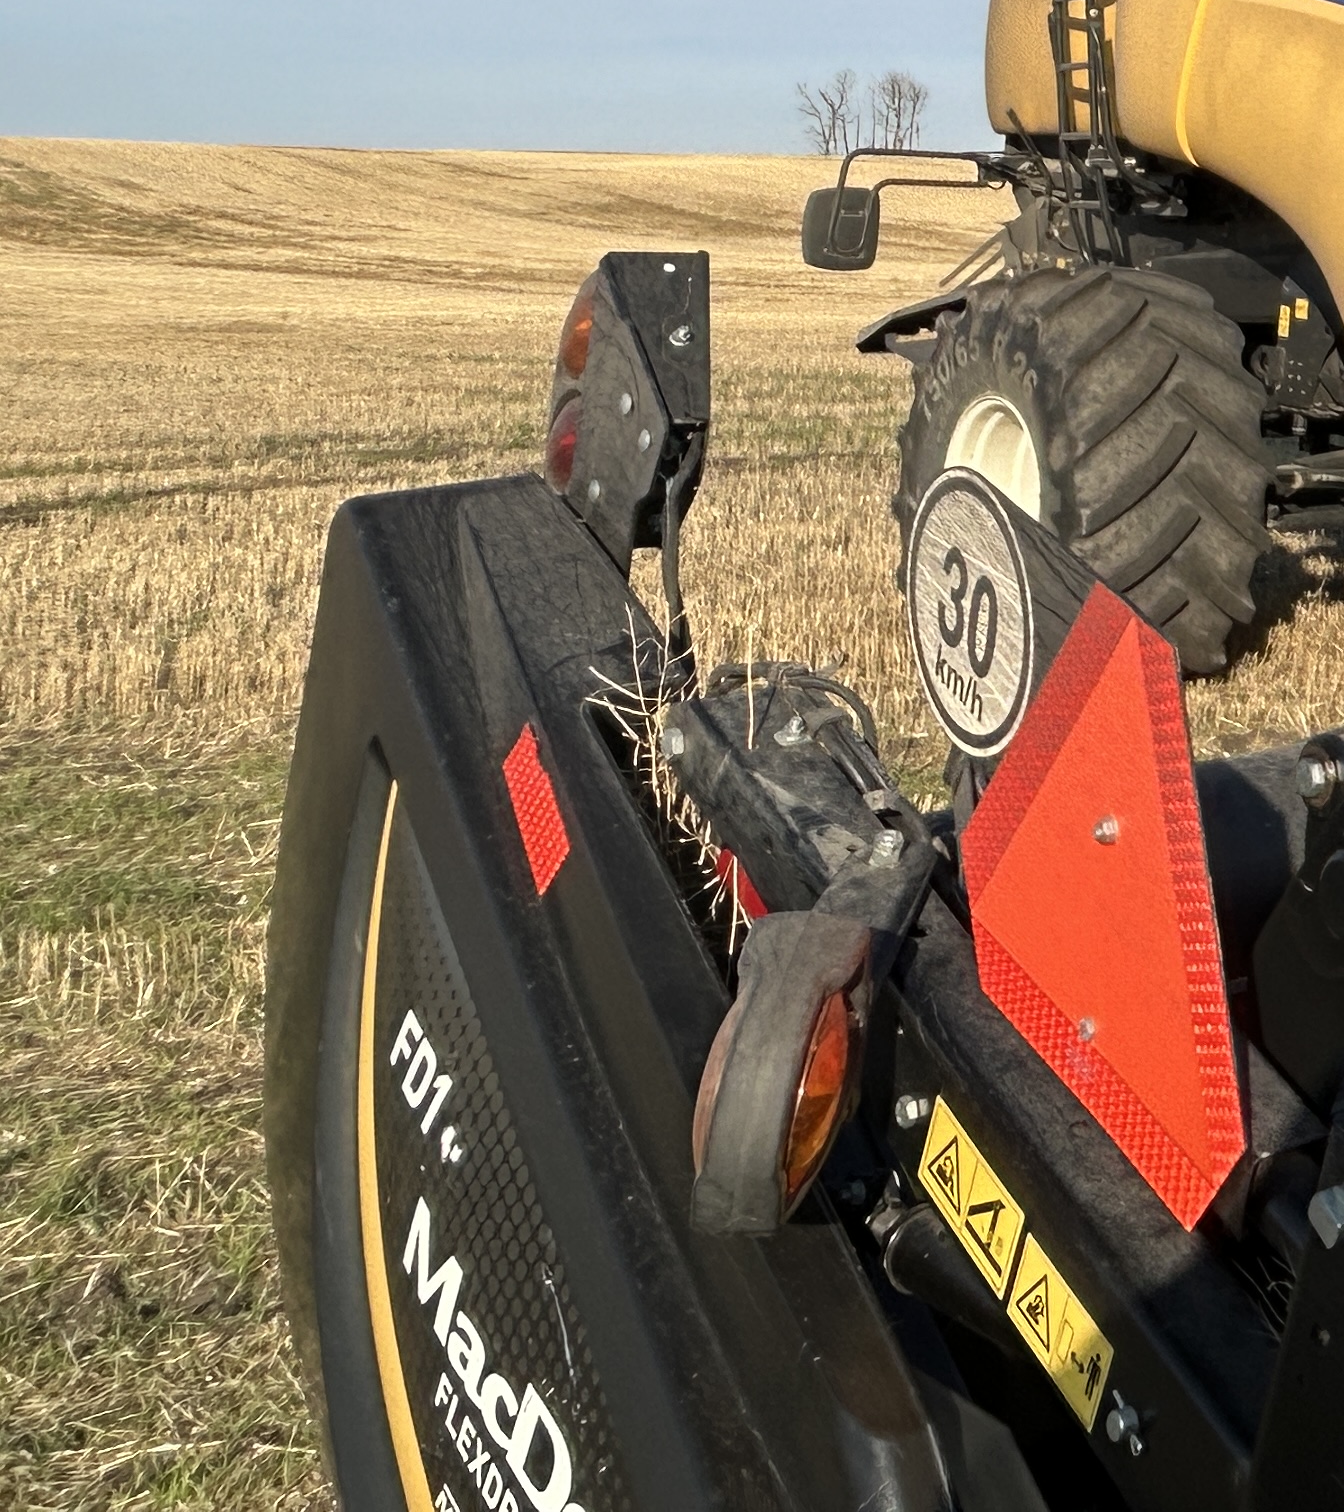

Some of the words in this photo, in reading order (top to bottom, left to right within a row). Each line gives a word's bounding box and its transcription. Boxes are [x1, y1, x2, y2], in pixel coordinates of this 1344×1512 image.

[938, 546, 998, 678] 30
[935, 642, 984, 722] km/h
[403, 1196, 587, 1511] MacD
